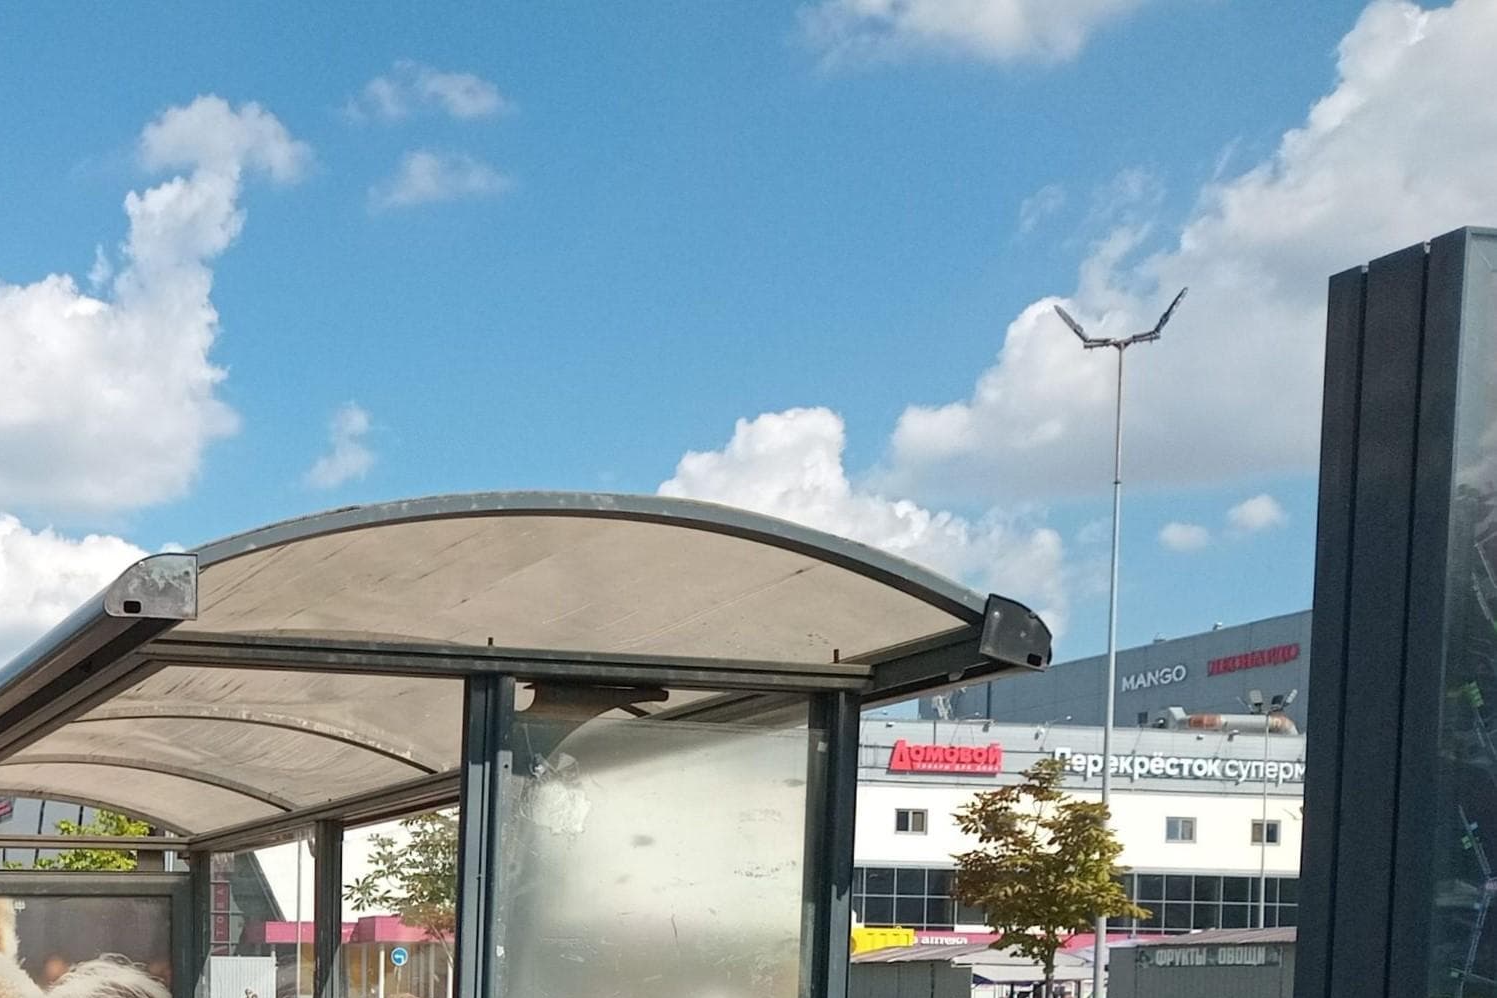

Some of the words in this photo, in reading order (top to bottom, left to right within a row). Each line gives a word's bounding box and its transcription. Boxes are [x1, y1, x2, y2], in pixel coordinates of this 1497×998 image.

[1121, 664, 1187, 692] MANGO
[1055, 747, 1221, 780] Перекрёсток
[1155, 948, 1207, 966] ФРУКТЫ
[1218, 946, 1266, 966] ОВОЩИ
